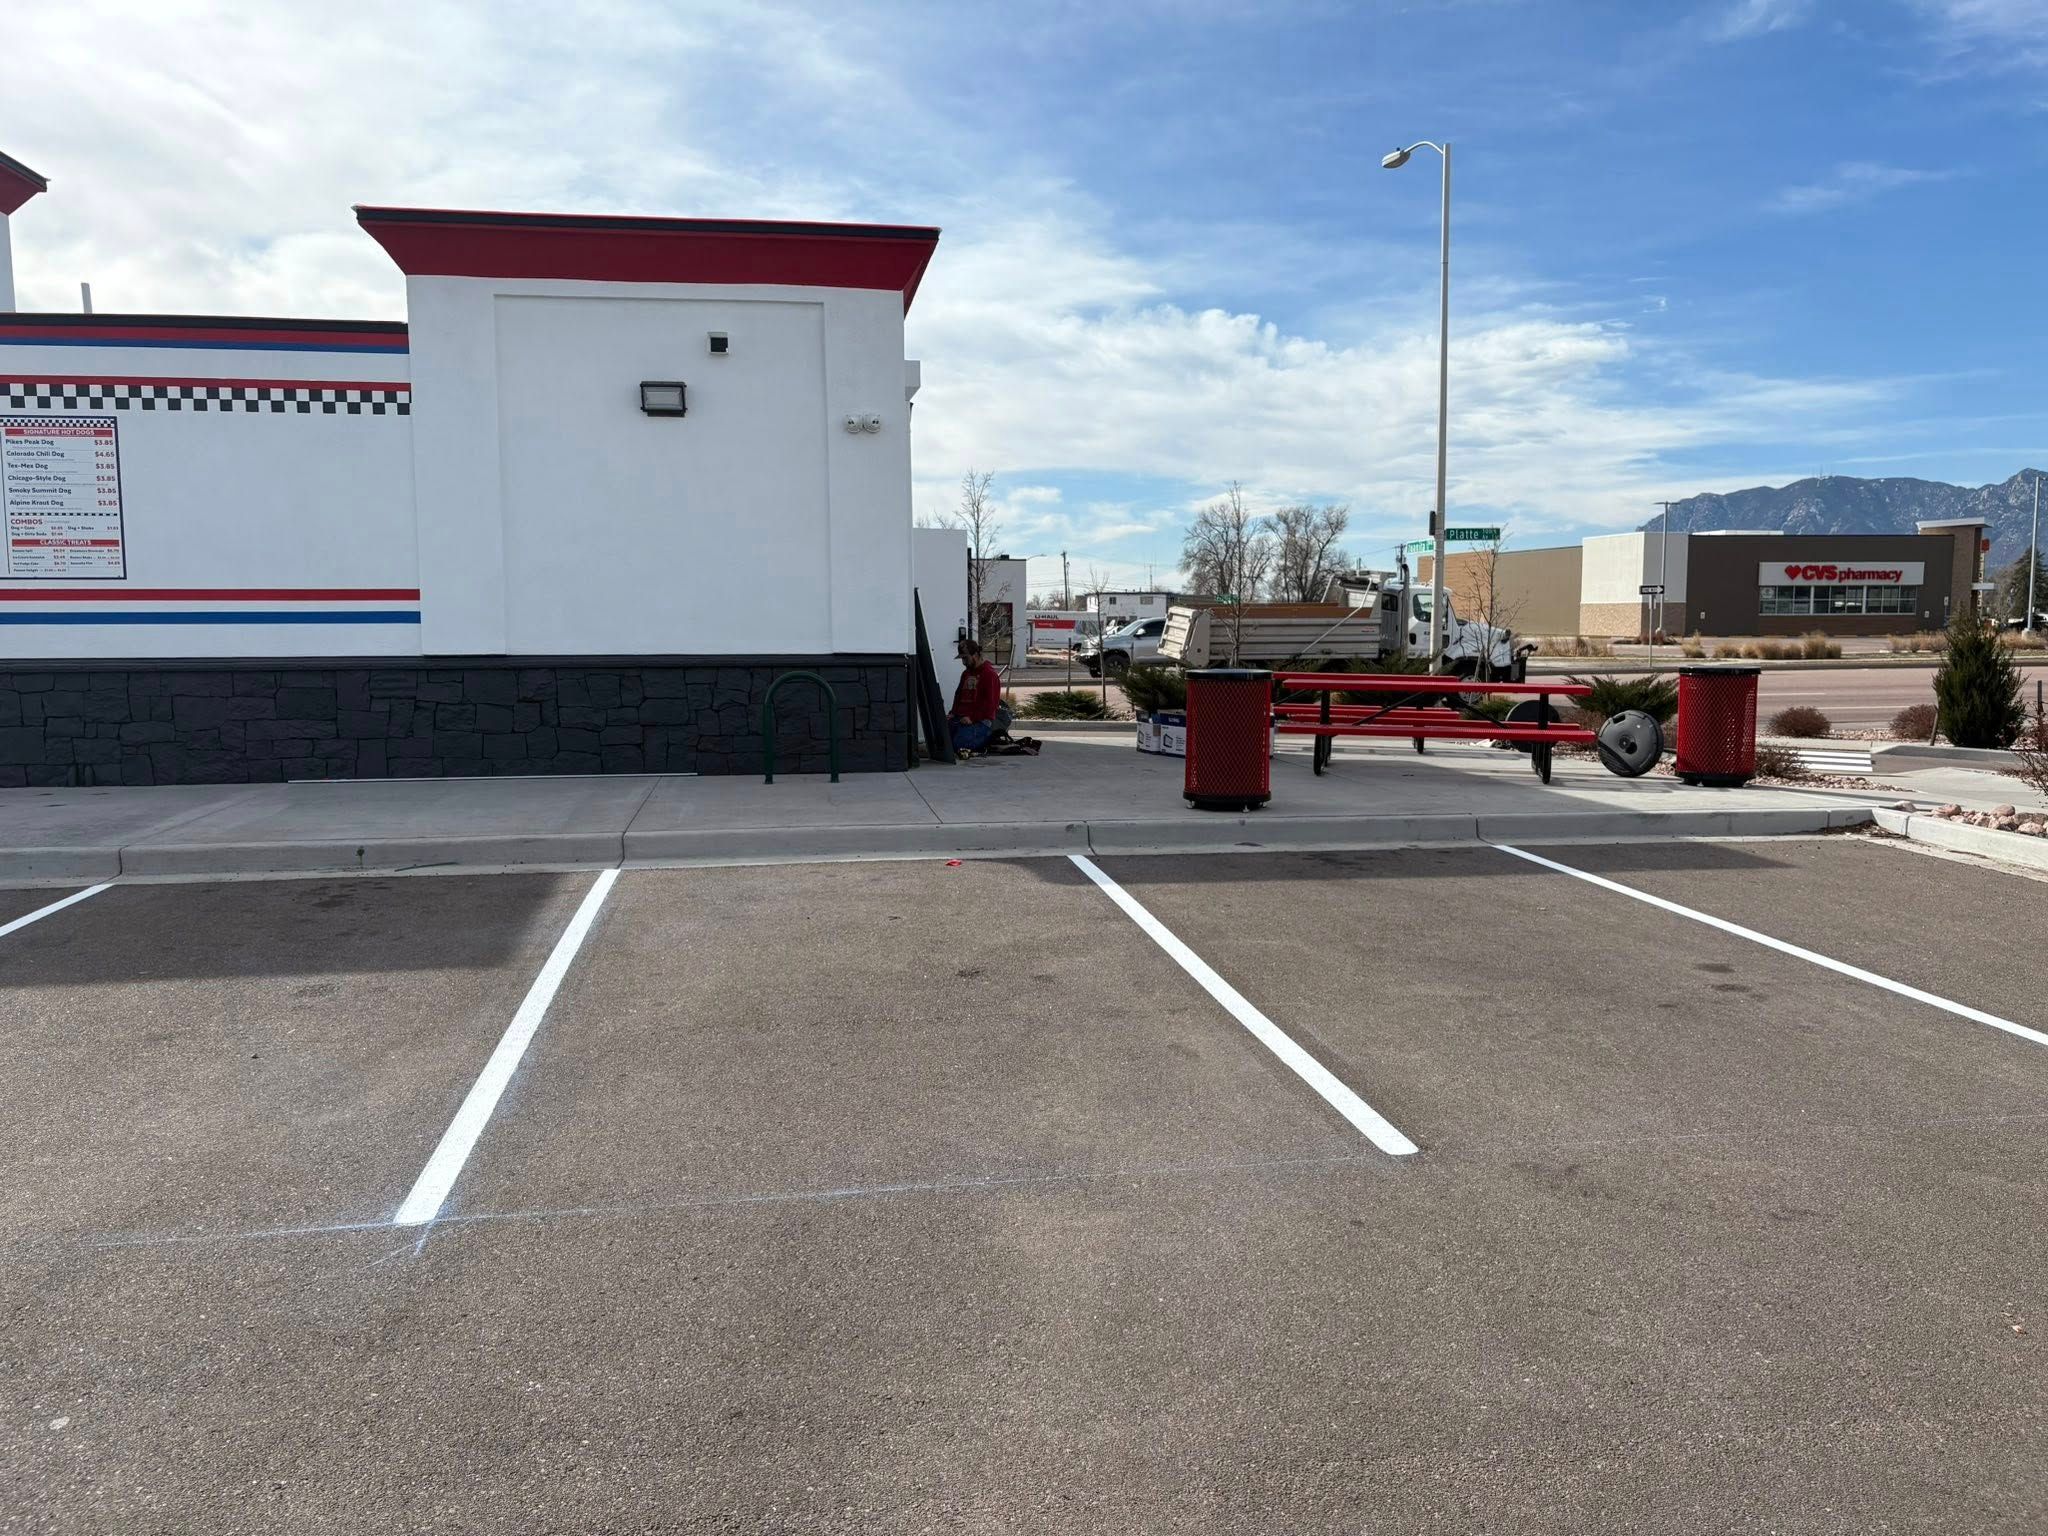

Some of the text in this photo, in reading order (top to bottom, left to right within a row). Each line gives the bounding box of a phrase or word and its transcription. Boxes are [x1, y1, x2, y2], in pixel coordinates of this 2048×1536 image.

[1449, 530, 1479, 539] Platte
[1802, 565, 1903, 582] CVS pharmacy
